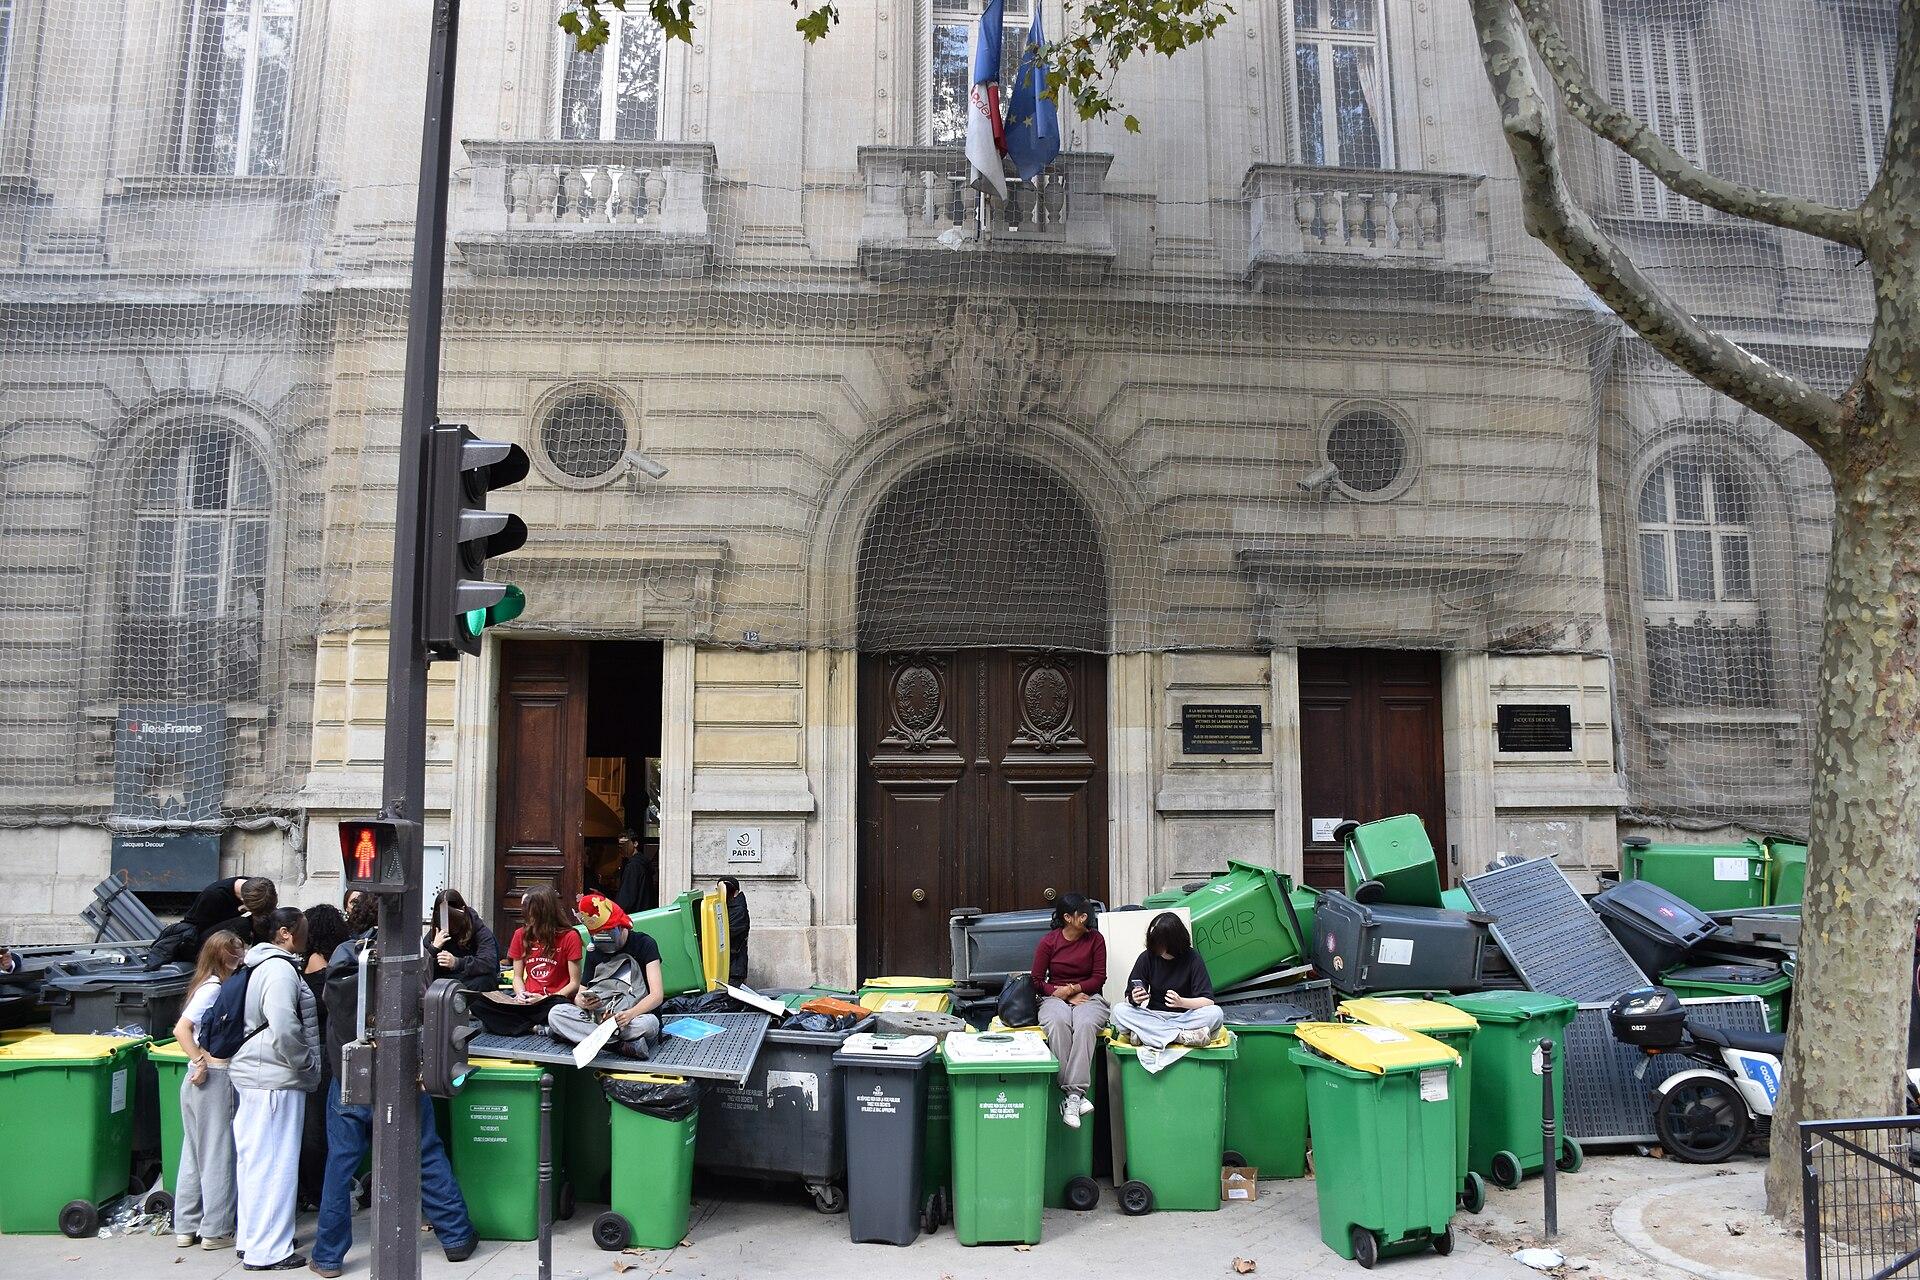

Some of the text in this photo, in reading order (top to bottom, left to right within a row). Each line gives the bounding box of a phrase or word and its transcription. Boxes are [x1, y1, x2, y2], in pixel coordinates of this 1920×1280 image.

[746, 631, 758, 640] 12
[1196, 911, 1255, 953] ACAB
[1760, 1066, 1776, 1094] cooltra
